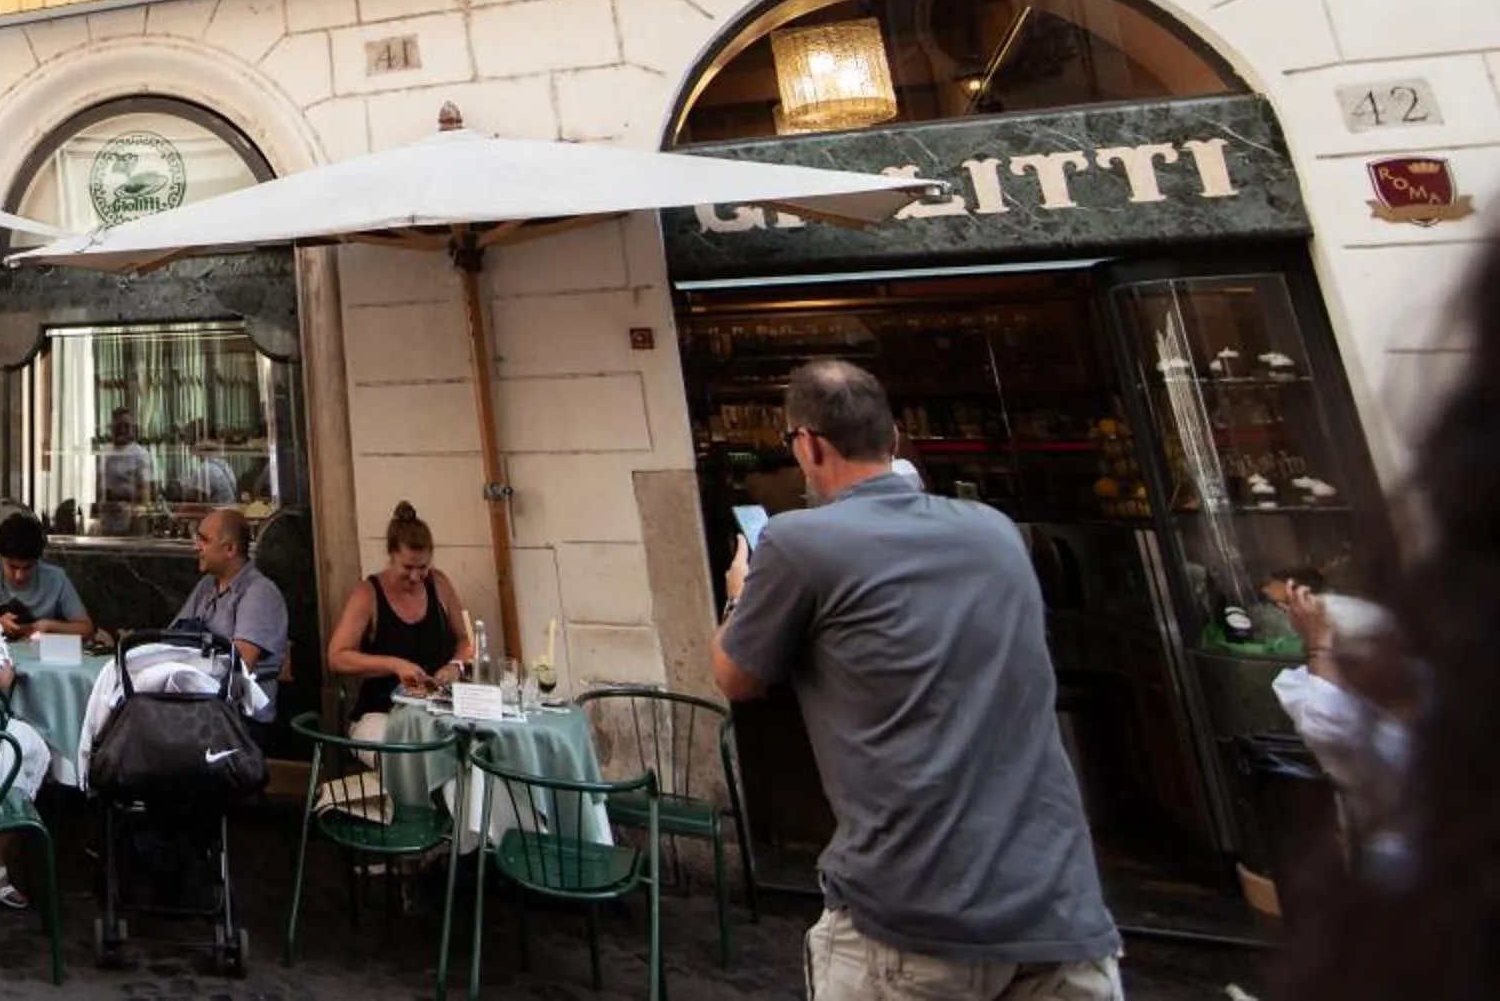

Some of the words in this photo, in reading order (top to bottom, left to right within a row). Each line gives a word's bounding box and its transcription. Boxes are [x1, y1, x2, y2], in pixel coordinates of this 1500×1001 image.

[373, 39, 409, 70] 41
[1351, 85, 1429, 126] 42
[1377, 165, 1443, 206] ROMA
